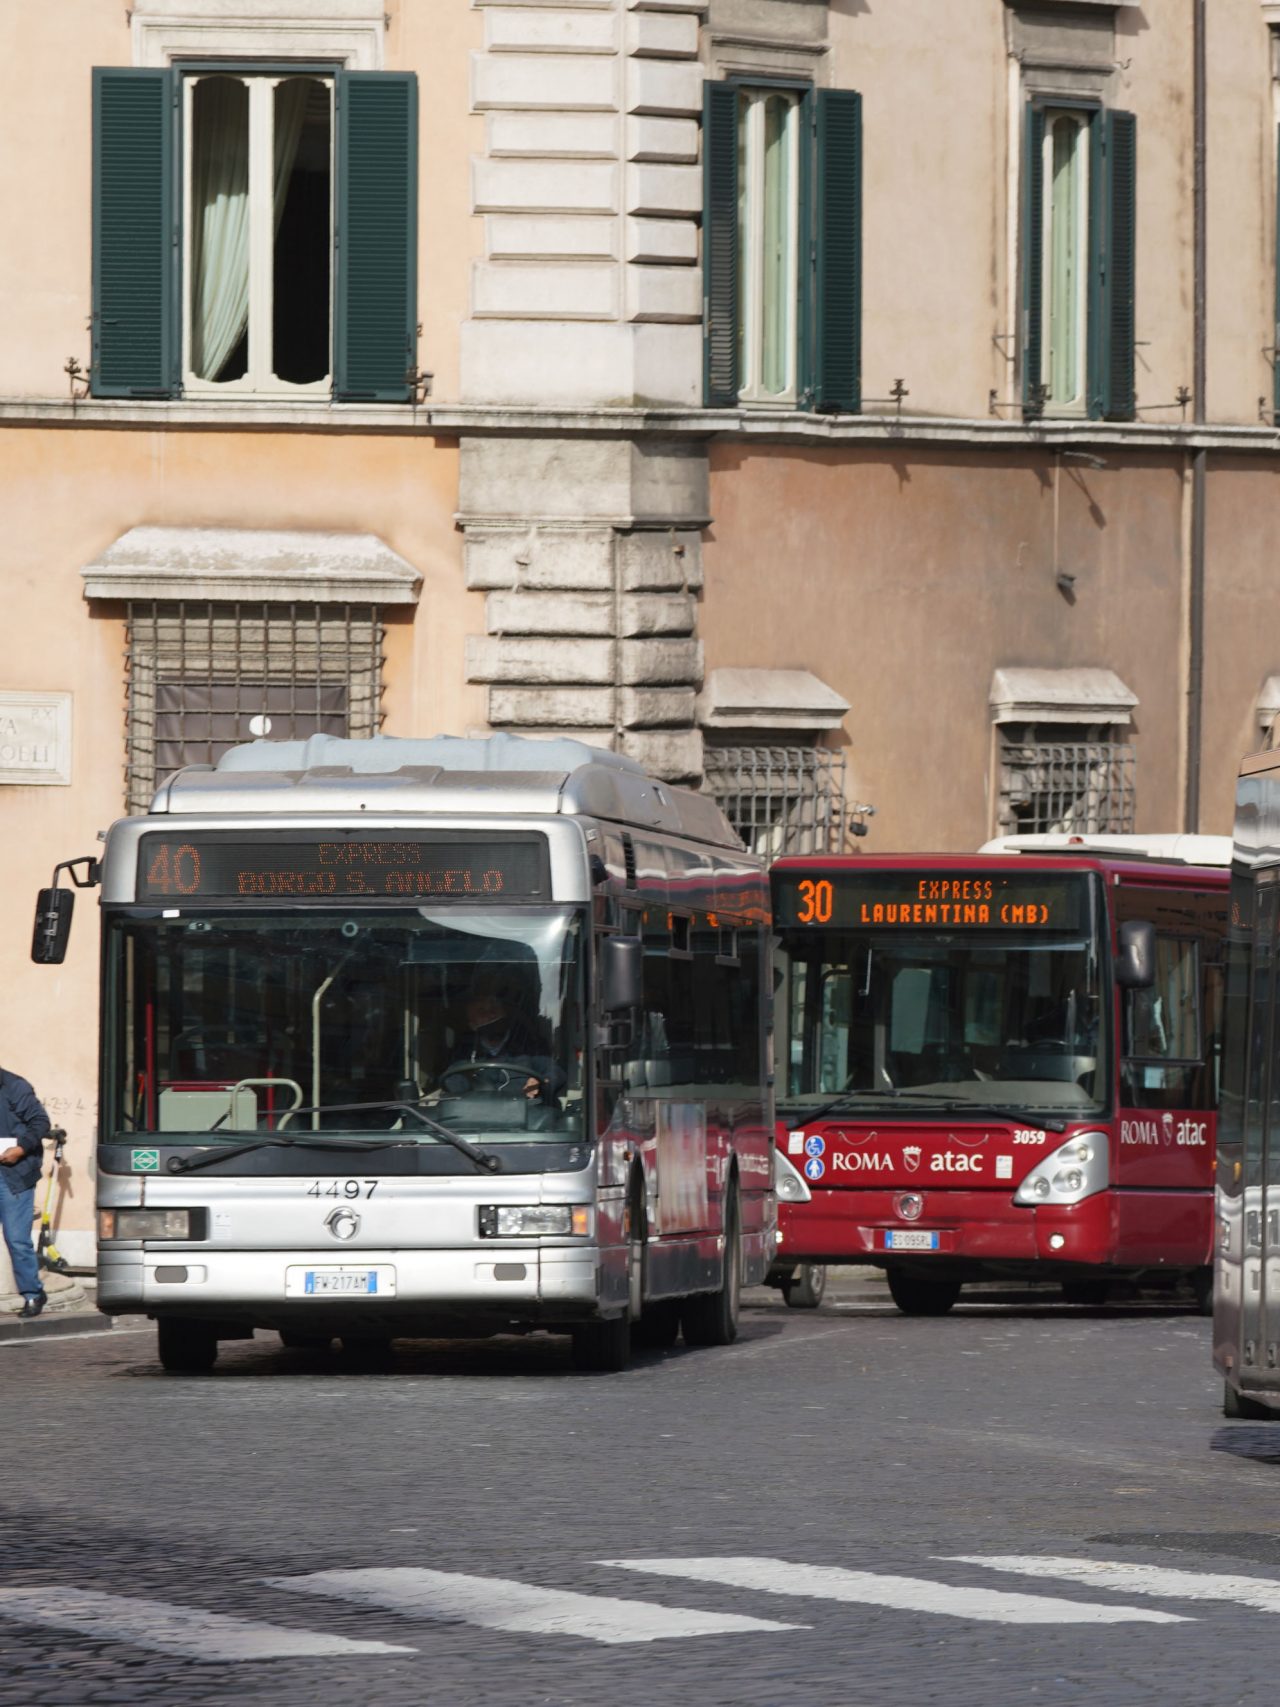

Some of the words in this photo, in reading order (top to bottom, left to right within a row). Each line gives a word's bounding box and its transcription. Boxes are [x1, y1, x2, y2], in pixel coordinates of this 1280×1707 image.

[318, 843, 421, 865] EXPRESS
[146, 843, 201, 894] 40
[237, 871, 336, 895] BORGO
[384, 869, 505, 894] ANGELO
[918, 880, 993, 900] EXPRESS
[797, 880, 833, 923] 30
[861, 904, 990, 923] LAURENTINA
[1000, 904, 1049, 924] (MB)
[1012, 1130, 1046, 1144] 3059
[1120, 1120, 1159, 1145] ROMA
[1176, 1118, 1207, 1146] atac
[832, 1152, 895, 1171] ROMA
[930, 1151, 984, 1172] atac
[306, 1179, 379, 1200] 4497
